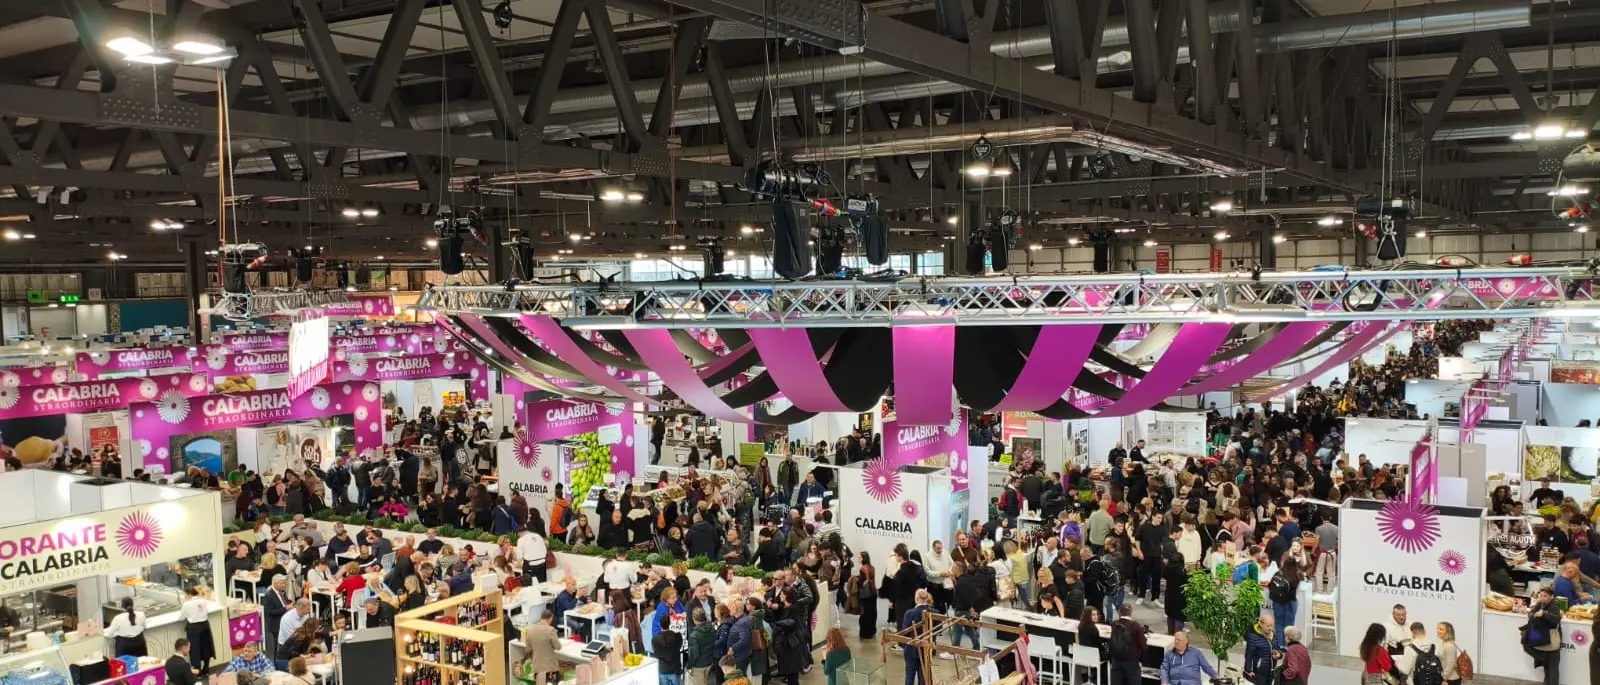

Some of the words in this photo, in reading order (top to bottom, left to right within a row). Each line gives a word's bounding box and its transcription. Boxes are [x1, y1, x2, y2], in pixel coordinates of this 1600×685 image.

[380, 327, 412, 335] CALABRIA
[231, 336, 272, 345] CALABRIA
[335, 337, 377, 347] CALABRIA
[118, 350, 173, 362] CALABRIA
[234, 353, 288, 367] CALABRIA
[376, 357, 431, 372] CALABRIA
[32, 383, 120, 403] CALABRIA
[33, 398, 121, 411] STRAORDINARIA
[203, 392, 292, 416] CALABRIA
[546, 403, 598, 422] CALABRIA
[203, 408, 293, 425] STRAORDINARIA
[898, 425, 939, 445] CALABRIA
[509, 482, 548, 493] CALABRIA
[855, 517, 912, 534] CALABRIA
[0, 523, 107, 560] ORANTE
[1, 546, 109, 580] CALABRIA
[1, 563, 111, 591] STRAORDINARIA
[1363, 571, 1455, 593] CALABRIA
[1363, 585, 1456, 601] STRAORDINARIA
